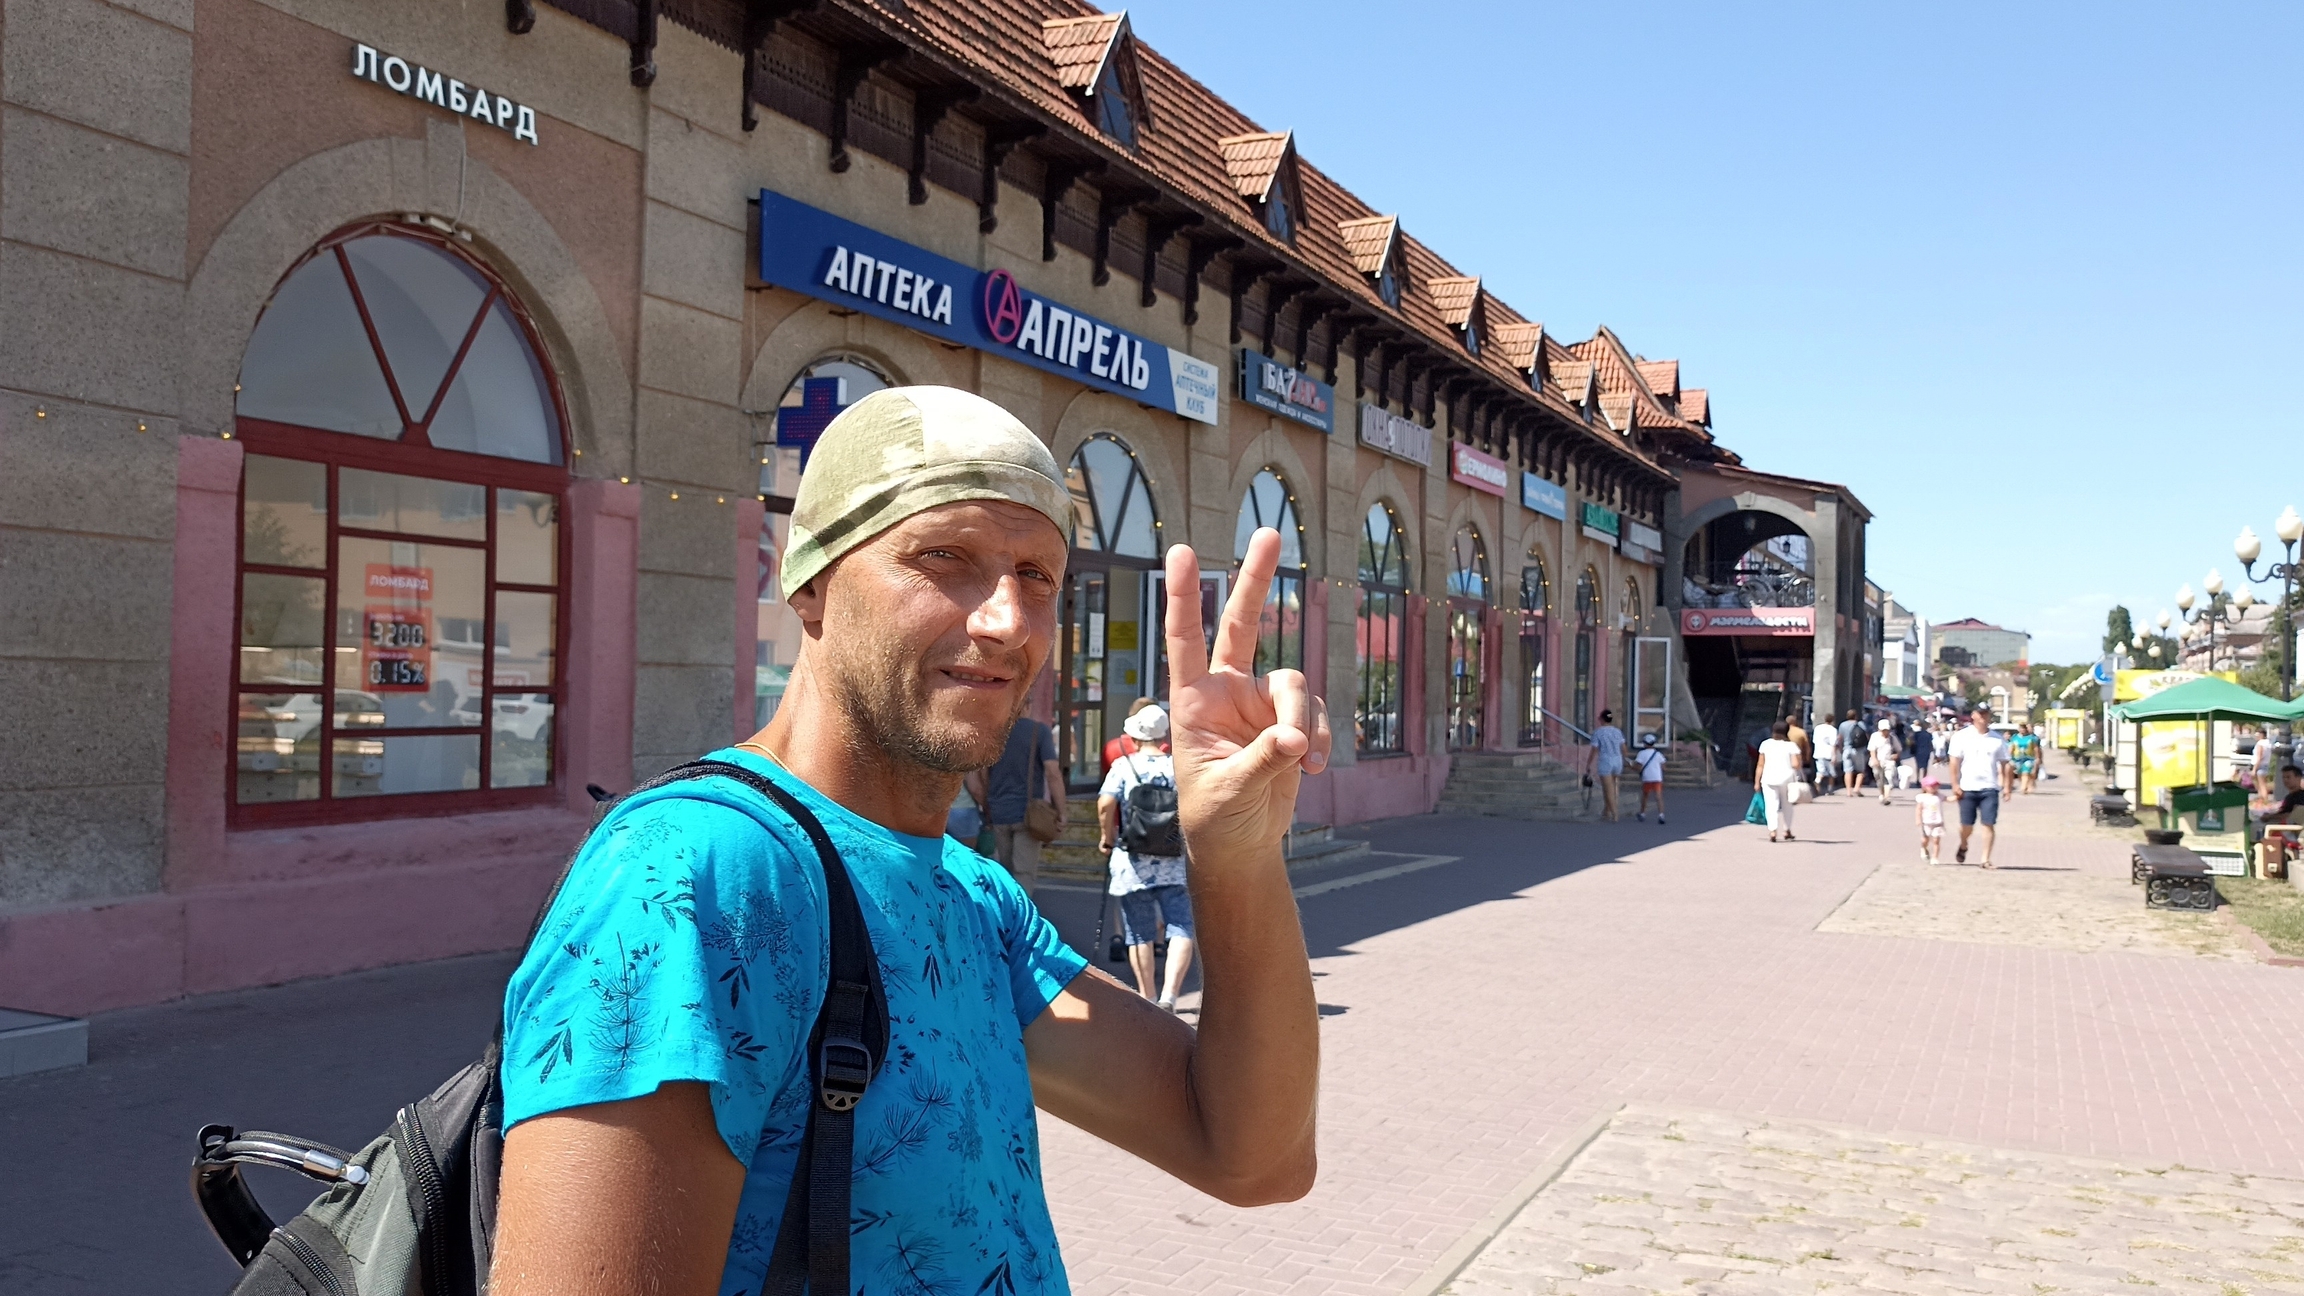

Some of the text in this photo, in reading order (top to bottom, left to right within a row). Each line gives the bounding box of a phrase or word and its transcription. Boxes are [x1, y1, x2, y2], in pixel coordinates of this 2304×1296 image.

[354, 43, 538, 146] ЛОМБАРД
[824, 245, 953, 326] АПТЕКА
[1017, 299, 1150, 391] АПРЕЛЬ
[369, 574, 430, 592] ЛОМБАРД
[372, 621, 425, 649] 3200
